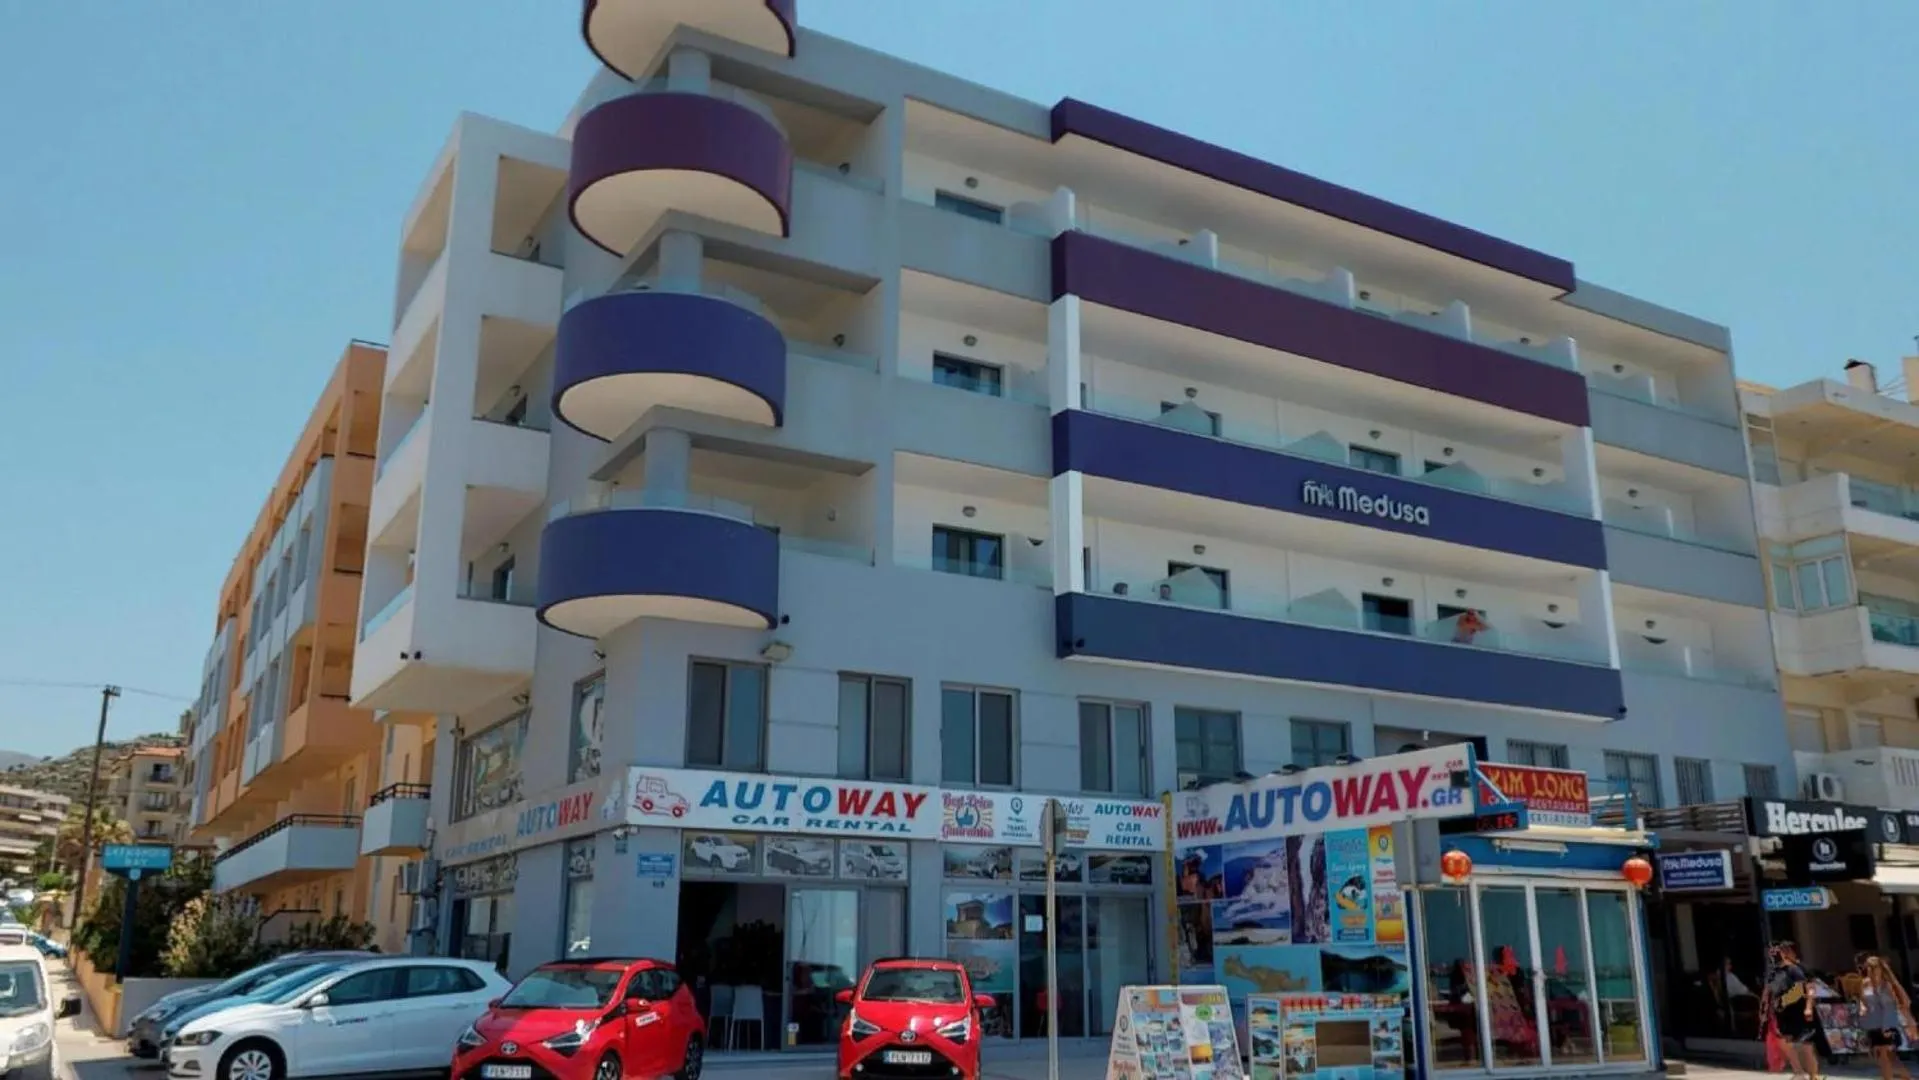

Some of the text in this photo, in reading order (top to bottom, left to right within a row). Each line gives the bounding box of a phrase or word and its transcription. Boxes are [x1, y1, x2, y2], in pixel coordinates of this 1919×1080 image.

[1338, 486, 1430, 527] Medusa
[1532, 772, 1585, 801] LONG
[700, 780, 929, 819] AUTOWAY
[1094, 803, 1161, 819] AUTOWAY
[516, 792, 594, 837] AUTOWAY
[732, 814, 912, 833] CAR RENTAL
[1115, 822, 1141, 833] CAR
[1105, 835, 1153, 847] RENTAL
